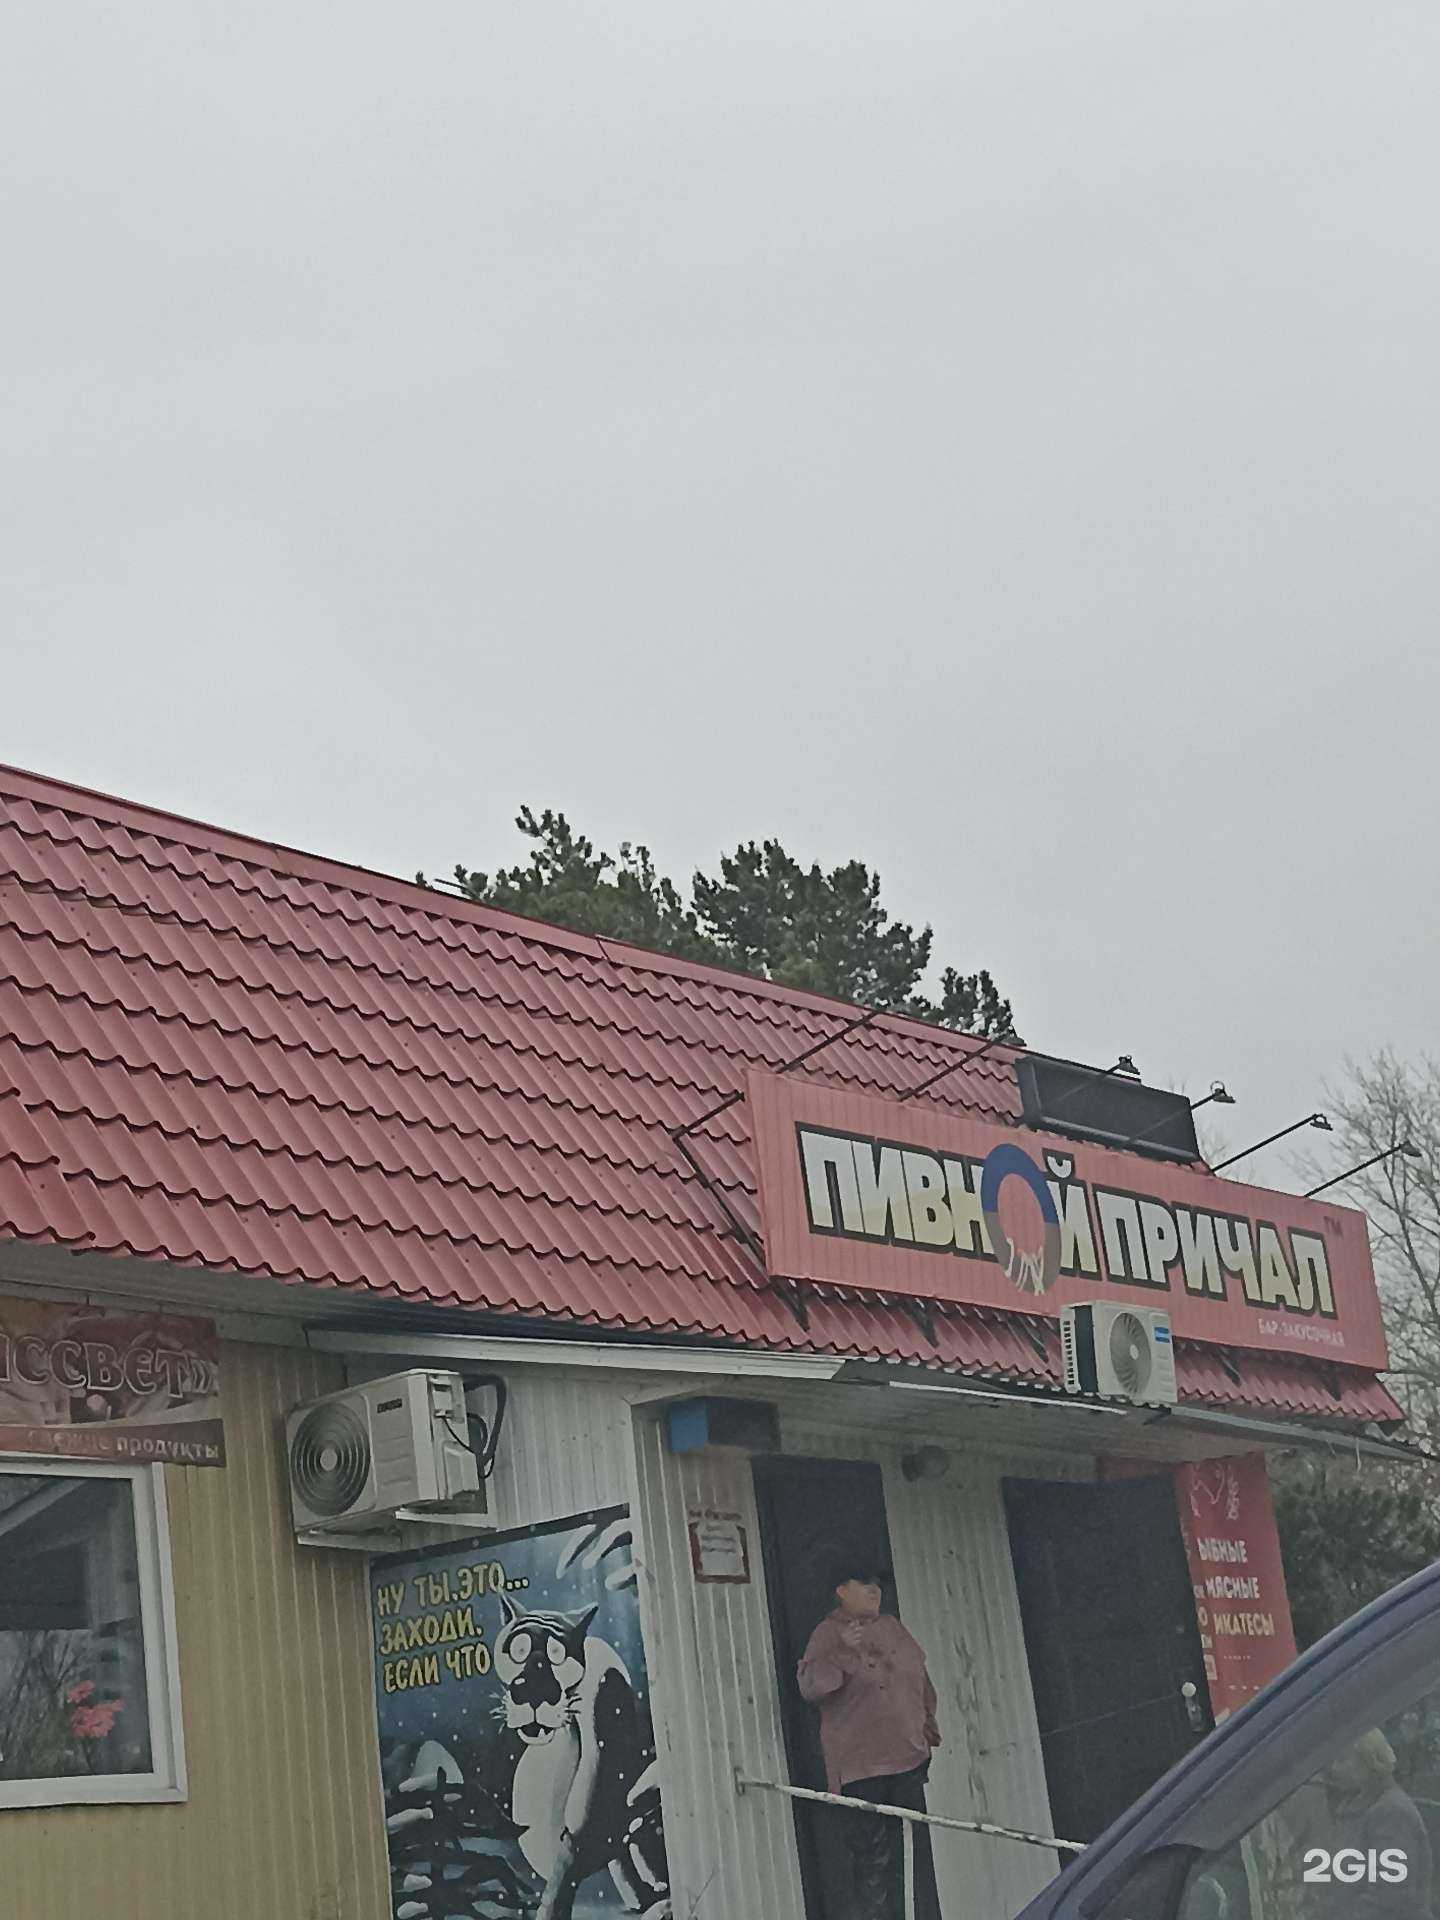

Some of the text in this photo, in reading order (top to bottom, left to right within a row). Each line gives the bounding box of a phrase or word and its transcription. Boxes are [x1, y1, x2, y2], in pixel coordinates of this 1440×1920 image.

[797, 1122, 1337, 1320] ПИВНОЙ ПРИЧАЛ
[116, 1436, 219, 1459] продукты
[377, 1583, 405, 1616] НУ
[1214, 1613, 1275, 1635] ИКАТЕСЫ
[384, 1643, 492, 1694] ЕСЛИ ЧТО
